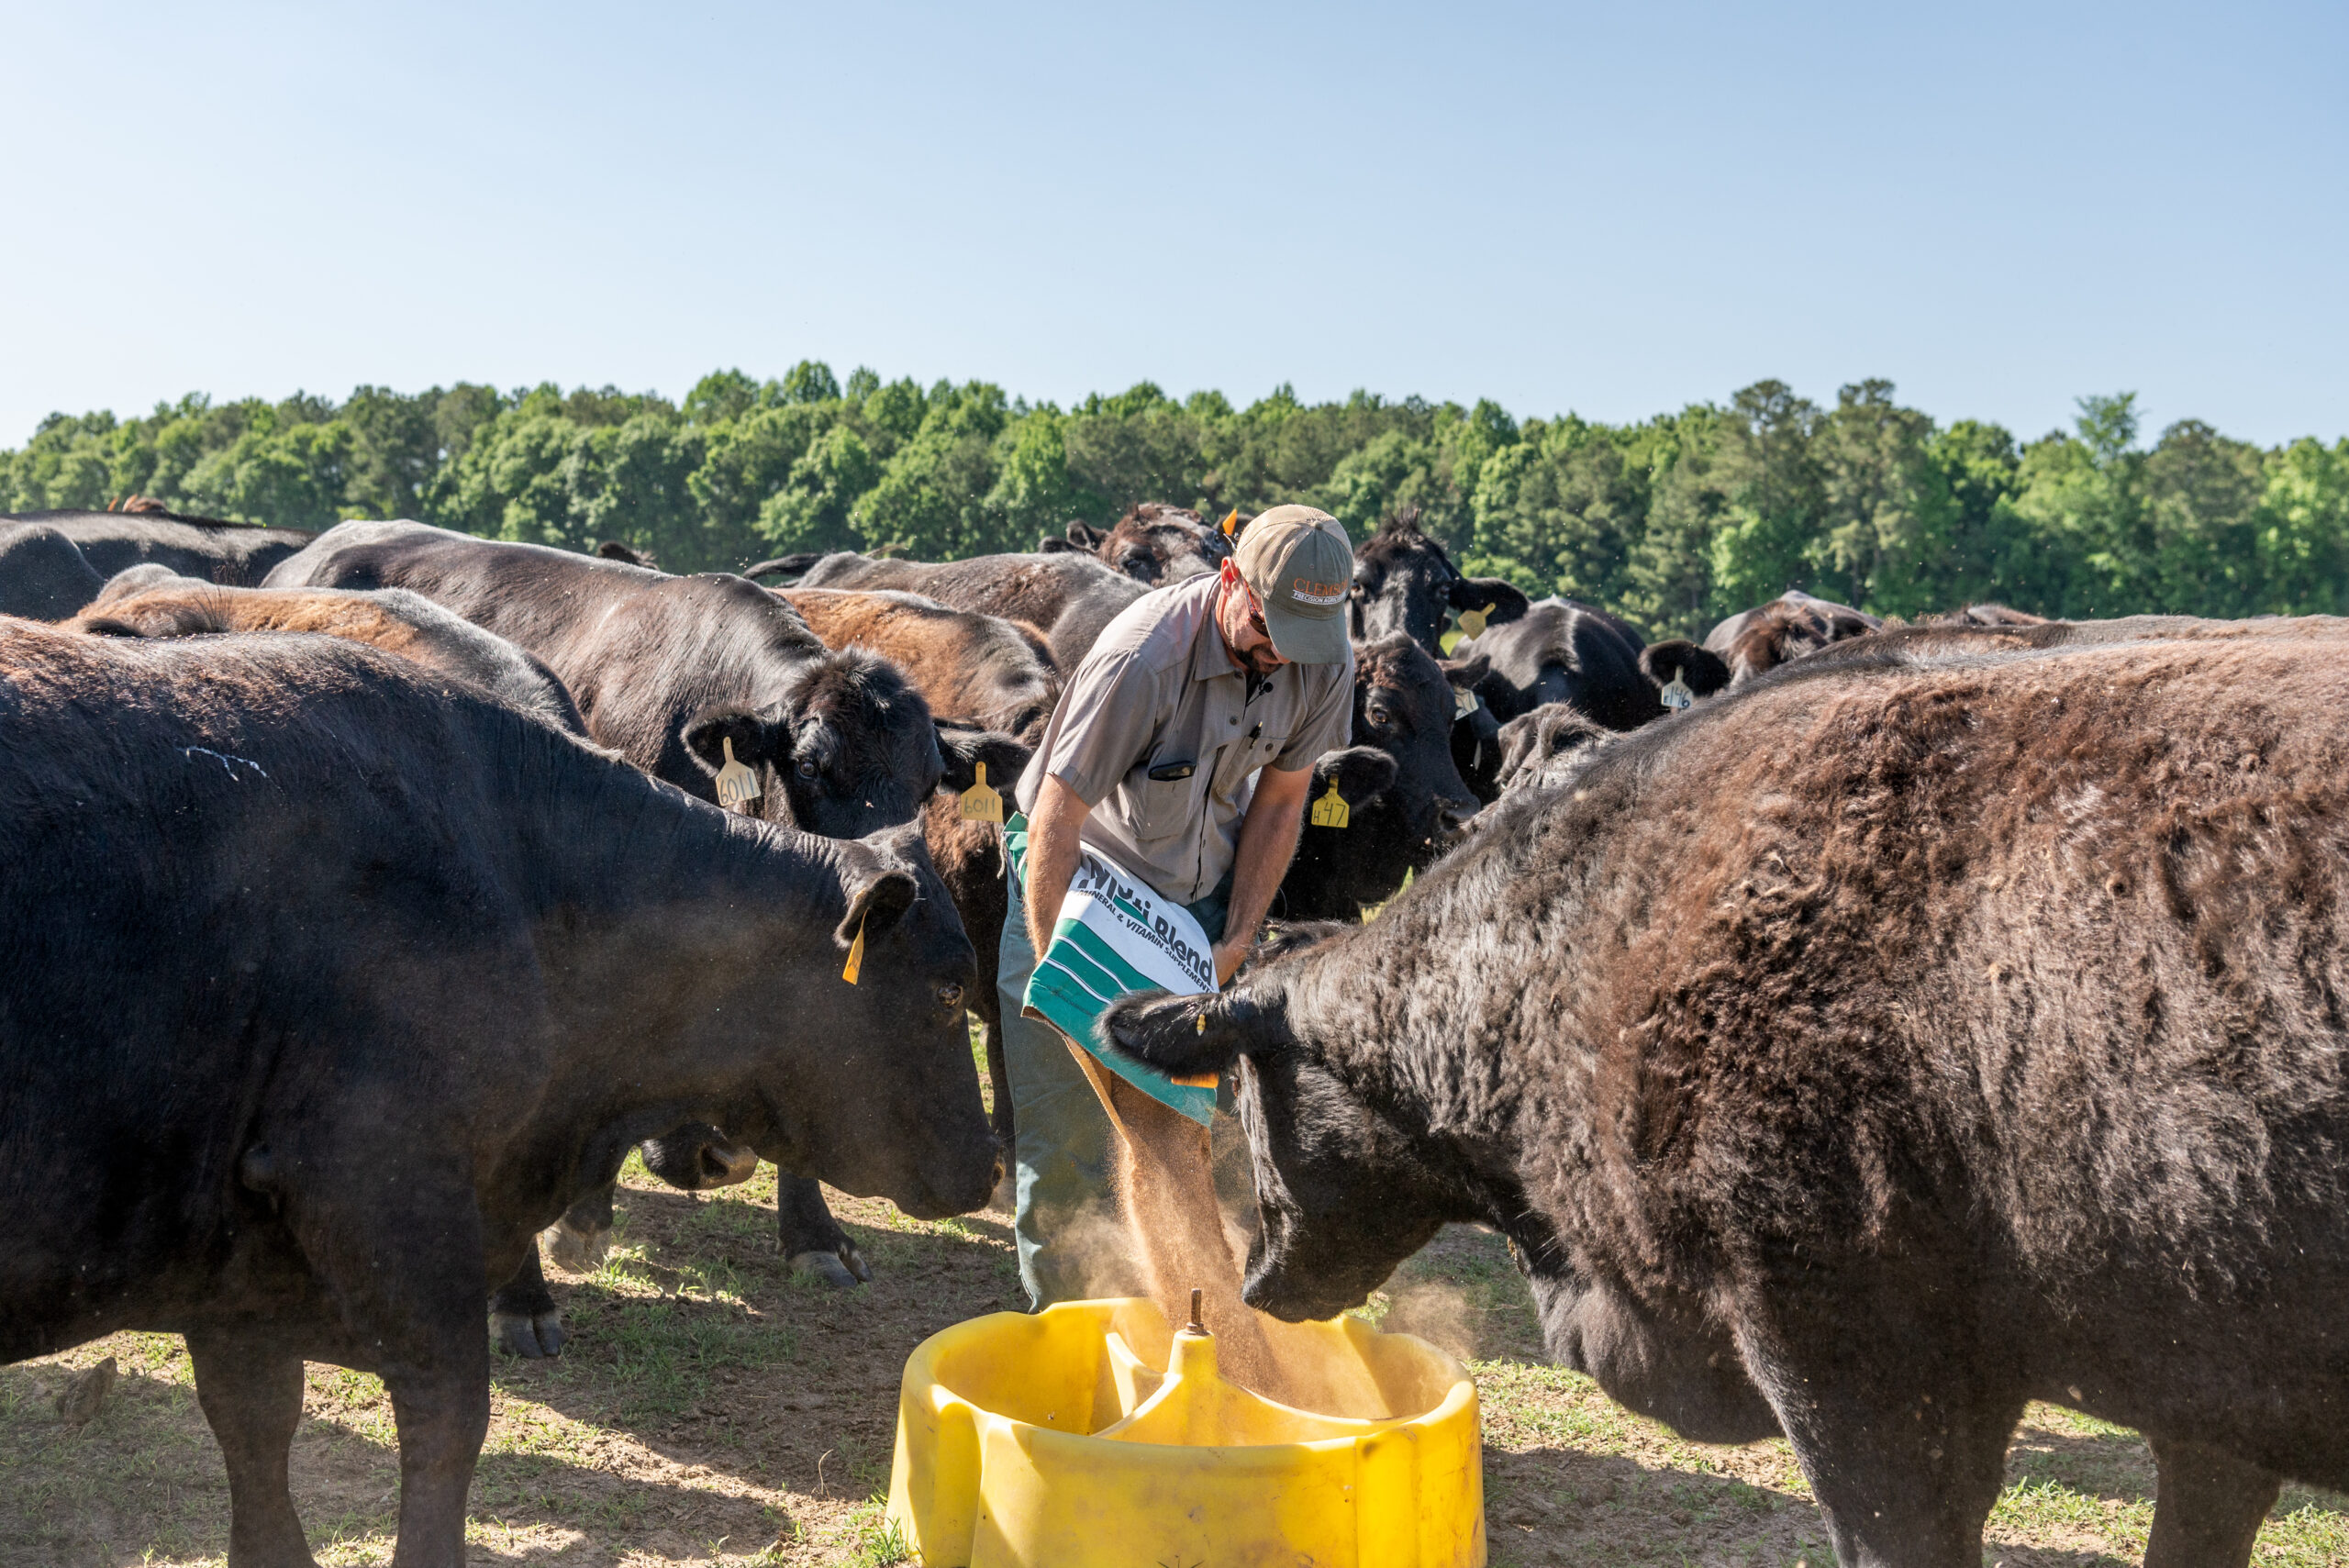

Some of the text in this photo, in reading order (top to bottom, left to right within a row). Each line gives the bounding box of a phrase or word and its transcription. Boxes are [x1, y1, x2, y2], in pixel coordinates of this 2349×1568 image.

[1294, 591, 1323, 604] PRECISION
[719, 772, 755, 805] 6011
[964, 796, 995, 815] 6011
[1077, 889, 1117, 916] MINERAL
[1117, 913, 1124, 923] &
[1126, 918, 1163, 949] VITAMIN
[1155, 915, 1212, 988] Blend
